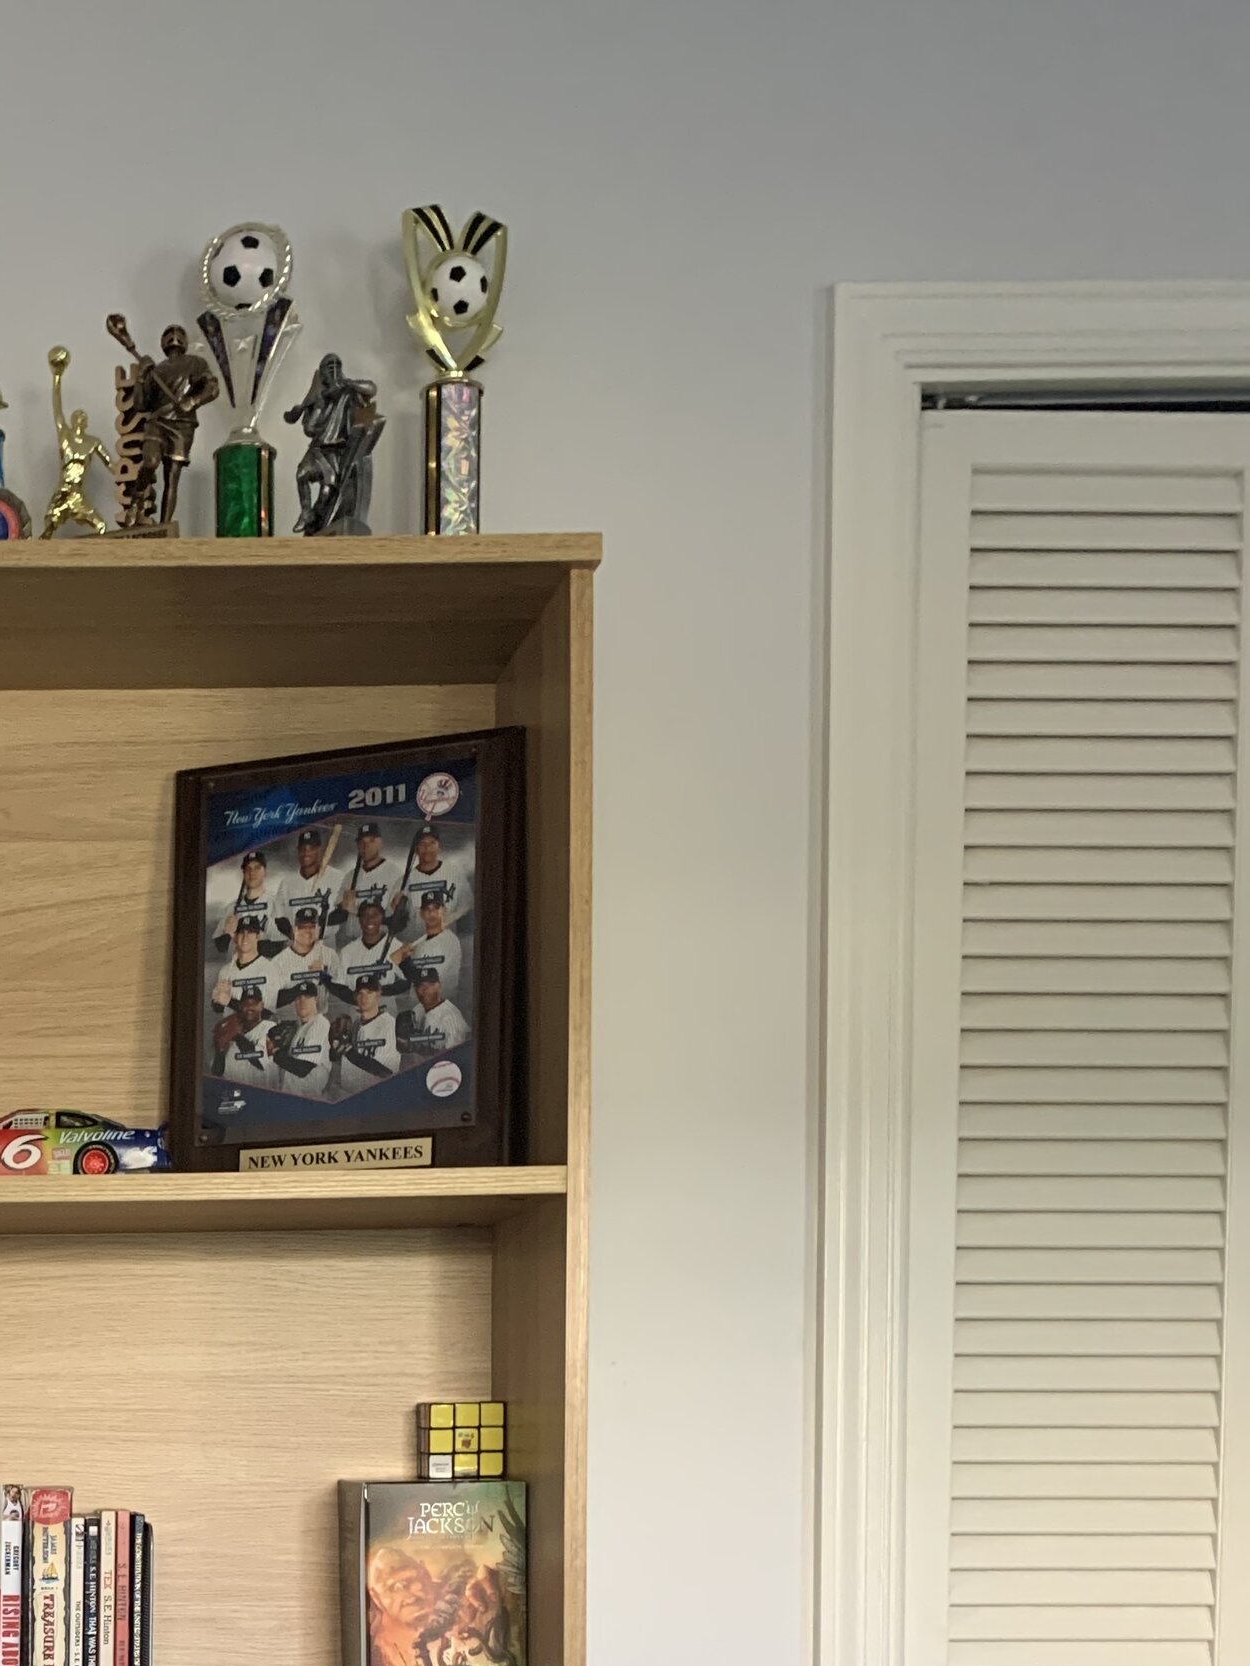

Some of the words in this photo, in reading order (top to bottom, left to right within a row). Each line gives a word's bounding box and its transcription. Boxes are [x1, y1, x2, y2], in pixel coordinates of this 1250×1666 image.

[348, 783, 406, 809] 2011
[224, 810, 251, 827] New
[253, 807, 282, 828] York
[286, 799, 339, 823] Yankees
[58, 1129, 136, 1145] Valvoline
[0, 1134, 49, 1171] 6
[248, 1154, 287, 1169] NEW
[291, 1150, 340, 1166] YORK
[344, 1145, 424, 1163] YANKEES
[419, 1500, 480, 1519] PERCY
[407, 1515, 495, 1541] JACKSON
[4, 1541, 12, 1575] ZUCKERMAN
[12, 1545, 20, 1570] GREGORY
[104, 1569, 112, 1590] TEX
[88, 1582, 96, 1613] HINTON
[117, 1585, 127, 1621] HINTON
[2, 1594, 21, 1638] RISING
[40, 1594, 55, 1661] TREASURE
[103, 1615, 112, 1645] Hinton
[88, 1637, 97, 1654] WAS
